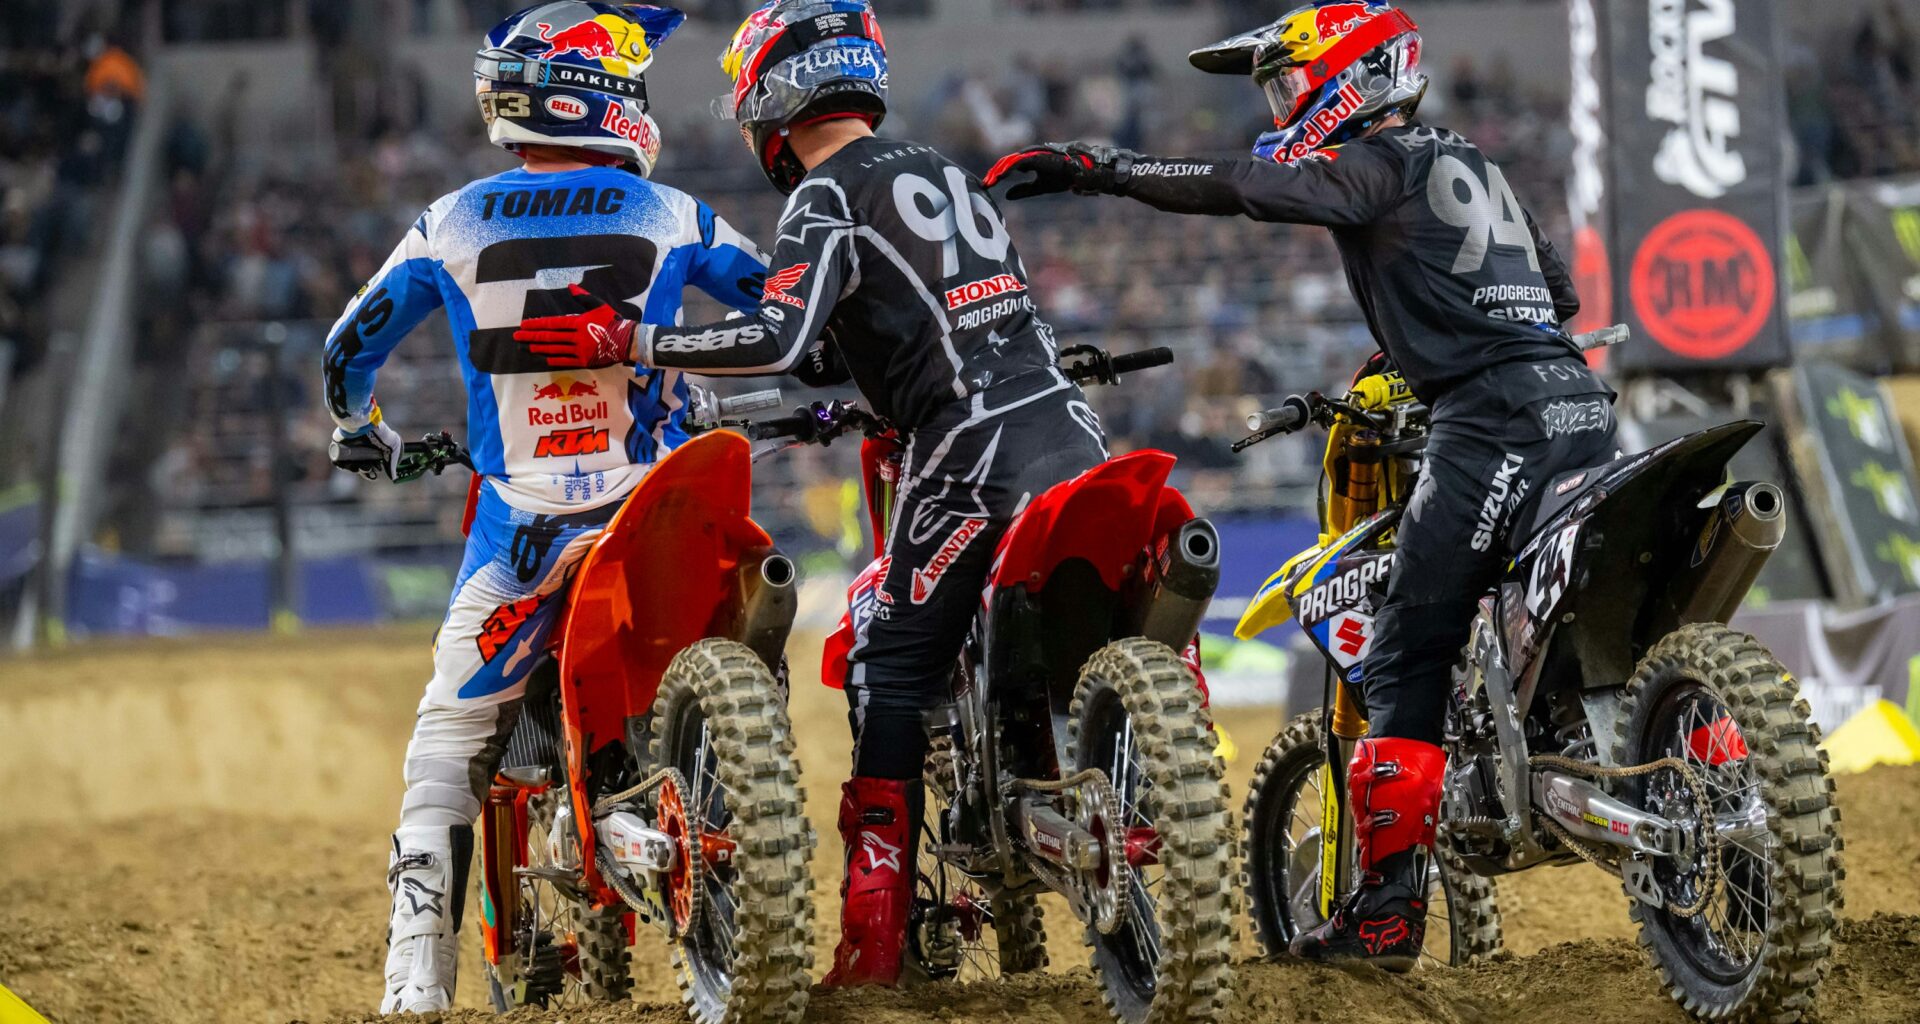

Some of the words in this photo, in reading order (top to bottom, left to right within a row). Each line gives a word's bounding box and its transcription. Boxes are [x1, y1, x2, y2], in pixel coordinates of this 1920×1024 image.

[560, 70, 637, 93] OAKLEY
[551, 100, 582, 115] BELL
[602, 101, 643, 142] Red
[1313, 82, 1364, 136] Bull
[1131, 162, 1213, 177] ROGRESSIVE
[482, 188, 625, 221] TOMAC
[1427, 155, 1541, 274] 94
[893, 166, 1010, 278] 96
[469, 234, 657, 372] 3
[946, 274, 1027, 309] HONDA
[1472, 285, 1554, 306] PROGRESSIV
[655, 323, 764, 353] astars
[1532, 364, 1588, 383] FOX
[528, 405, 567, 426] Red
[570, 401, 608, 423] Bull
[533, 426, 609, 458] KTM
[595, 471, 604, 492] ECH
[1471, 453, 1524, 552] SUZUKI
[924, 518, 985, 583] HONDA
